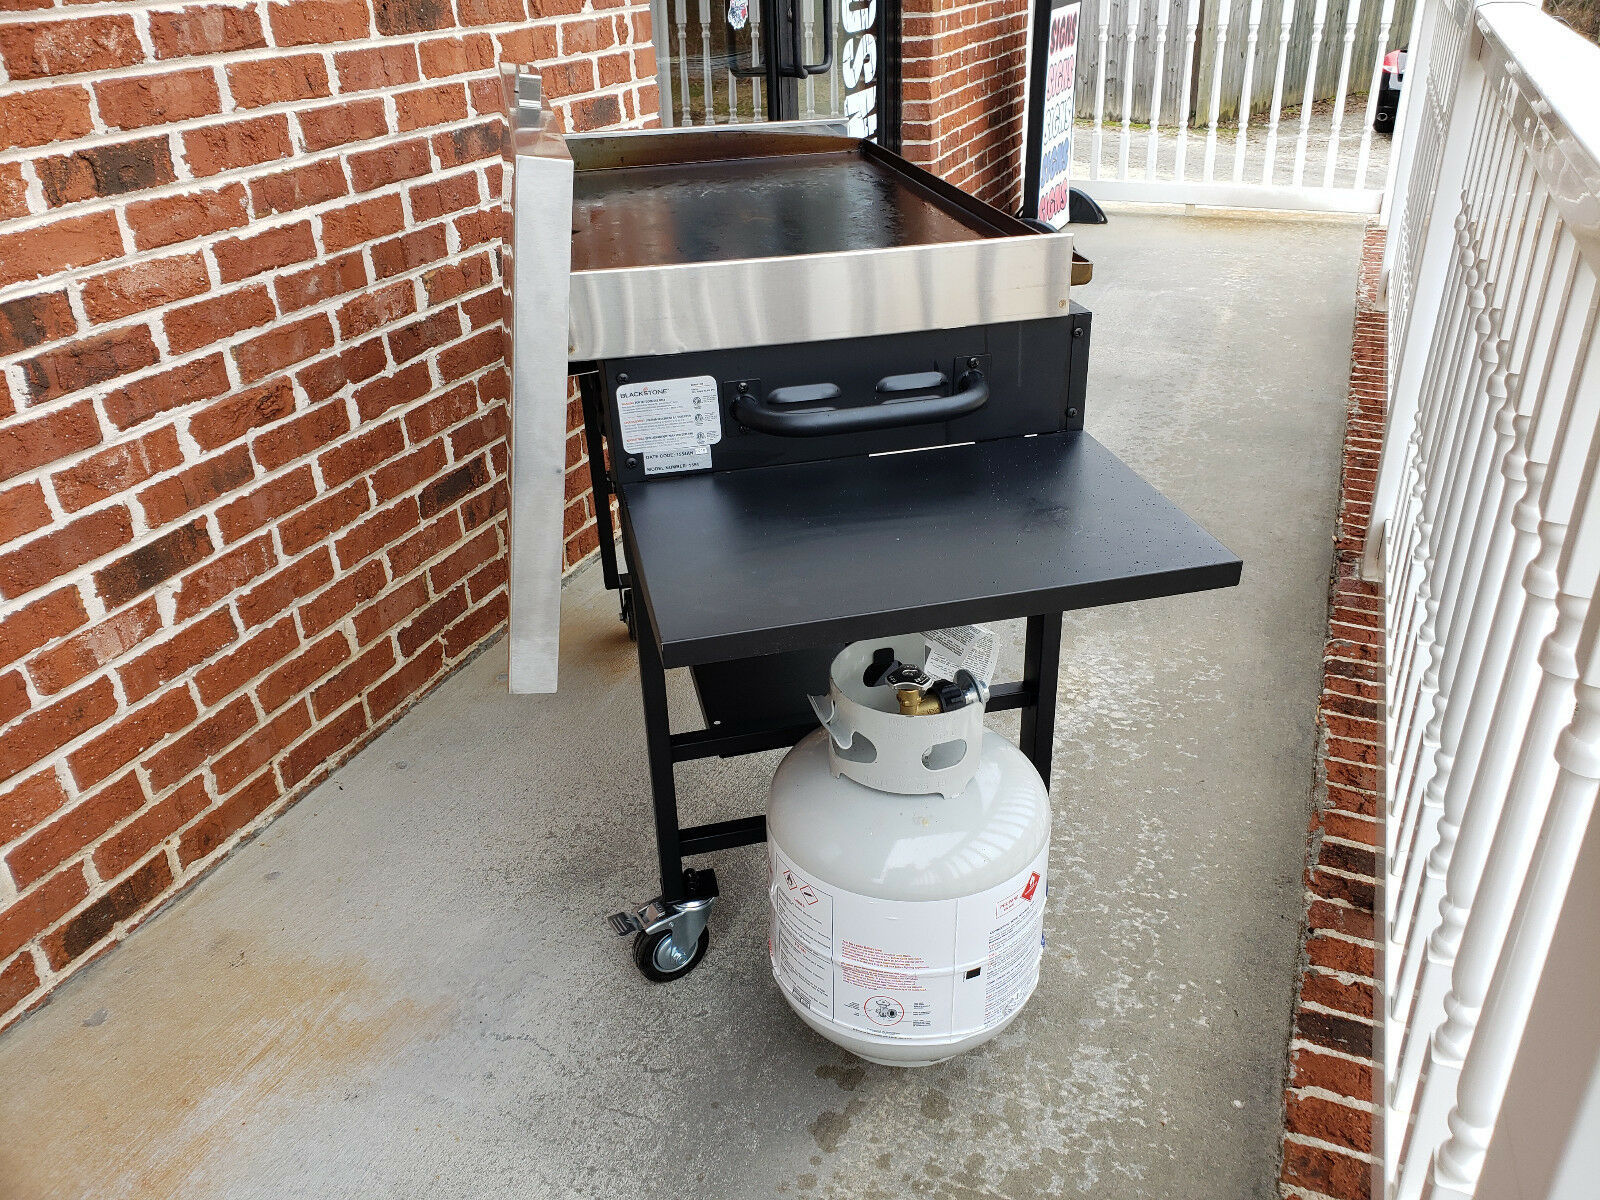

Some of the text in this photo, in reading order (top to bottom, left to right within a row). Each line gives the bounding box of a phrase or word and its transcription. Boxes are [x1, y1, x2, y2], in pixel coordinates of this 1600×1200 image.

[1050, 11, 1077, 56] SIGNS
[1047, 54, 1074, 101] SIGNS
[1043, 96, 1071, 145] SIGNS
[1041, 137, 1069, 188] SIGNS
[1039, 177, 1067, 222] SIGNS
[620, 388, 668, 398] BLACKSTONE
